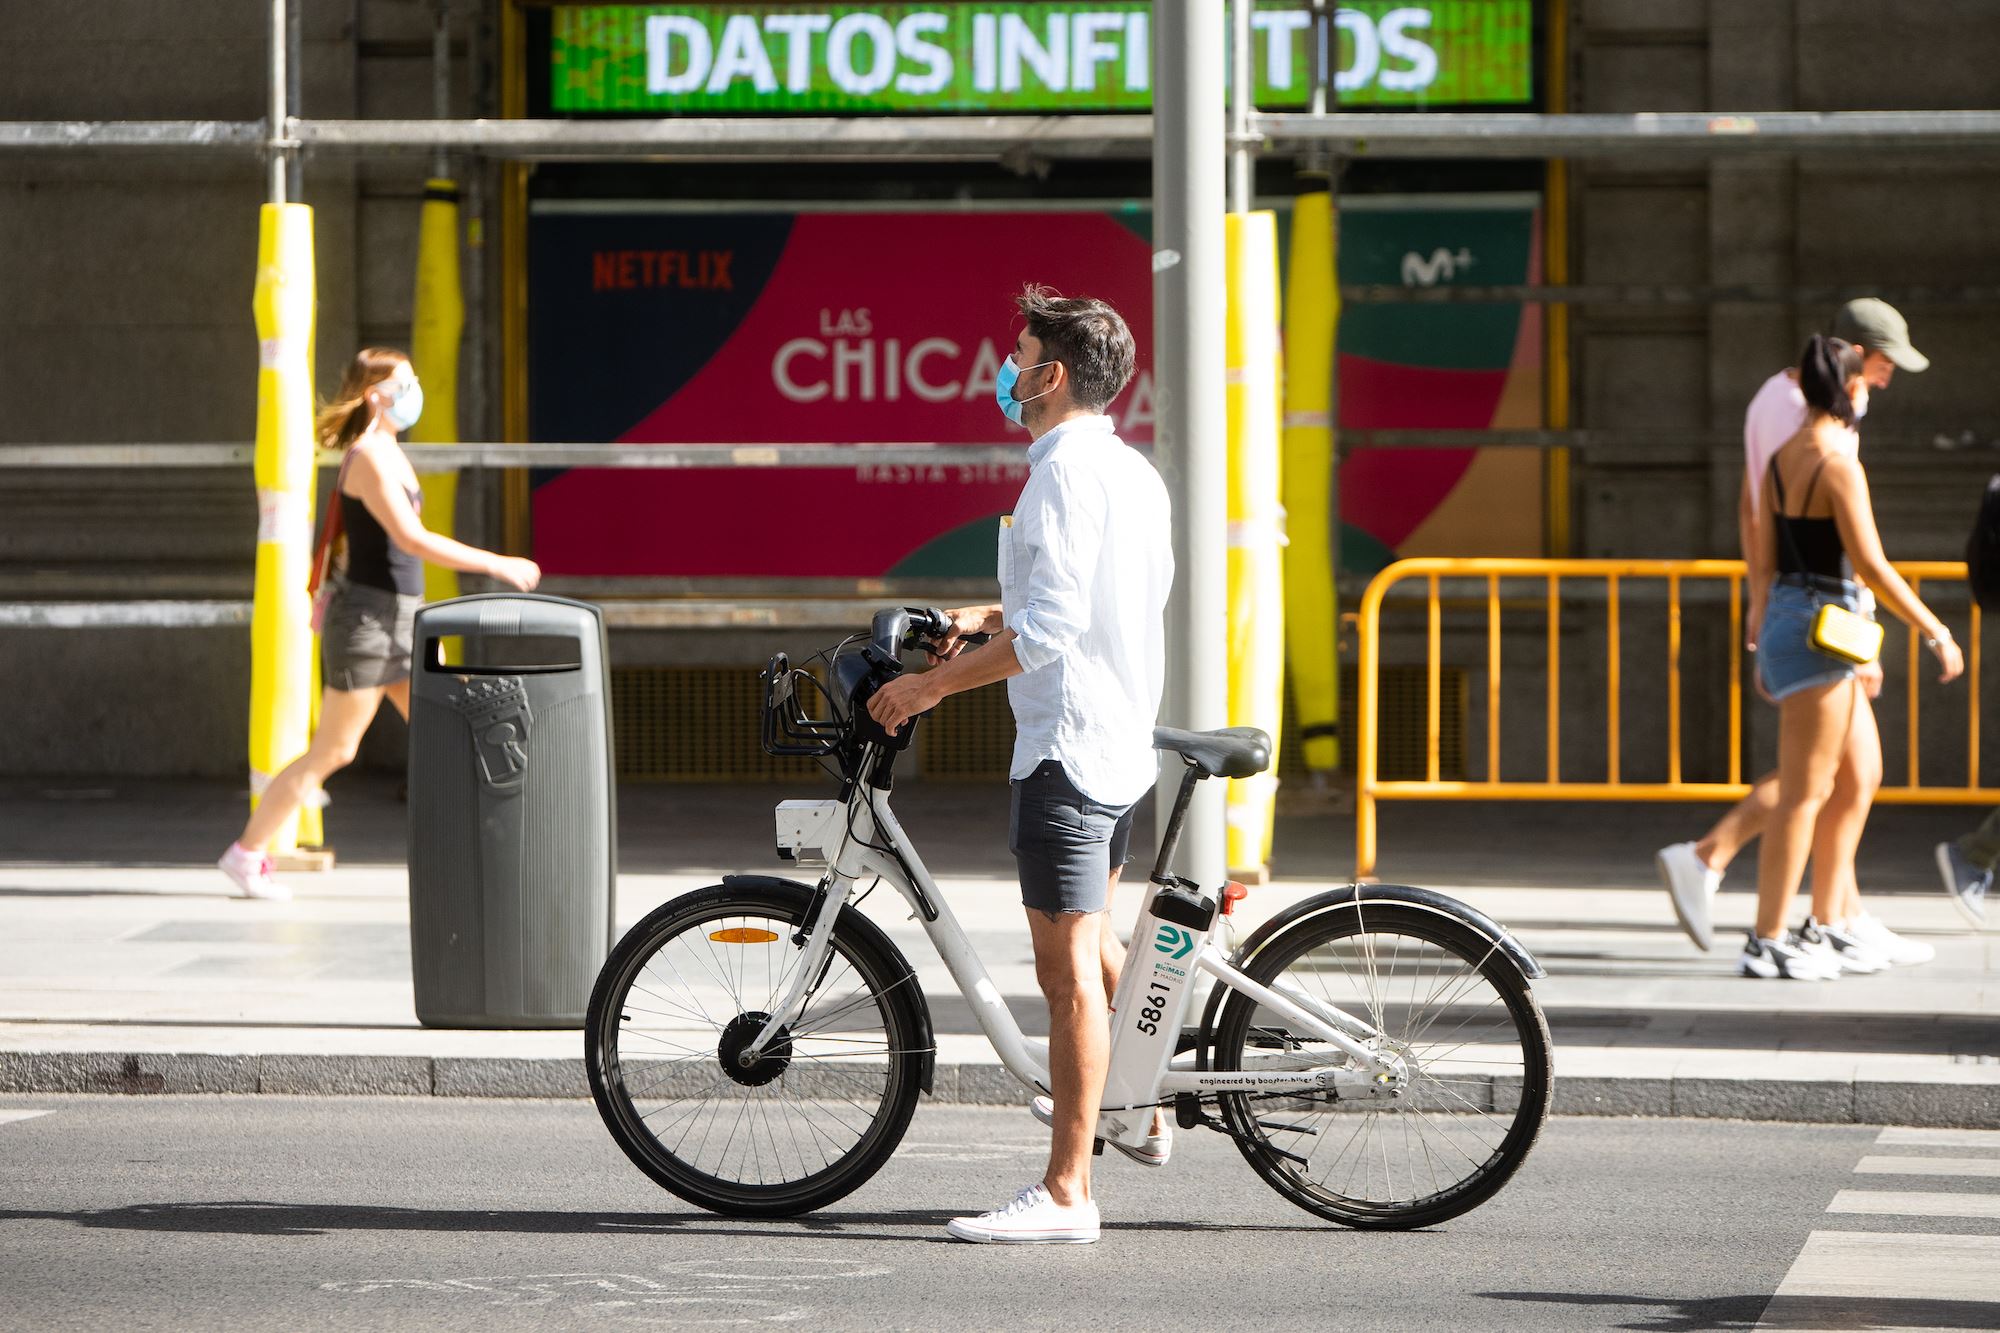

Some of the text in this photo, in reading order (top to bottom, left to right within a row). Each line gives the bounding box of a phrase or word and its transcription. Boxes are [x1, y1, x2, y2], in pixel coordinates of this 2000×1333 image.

[645, 8, 1438, 95] DATOS INFITOS
[593, 250, 734, 291] NETFLIX
[820, 307, 873, 336] LAS
[772, 338, 1000, 403] CHICA
[1155, 962, 1186, 977] BiciMAD
[1137, 982, 1171, 1037] 5861
[1200, 1077, 1243, 1086] engineered
[1245, 1077, 1256, 1086] by
